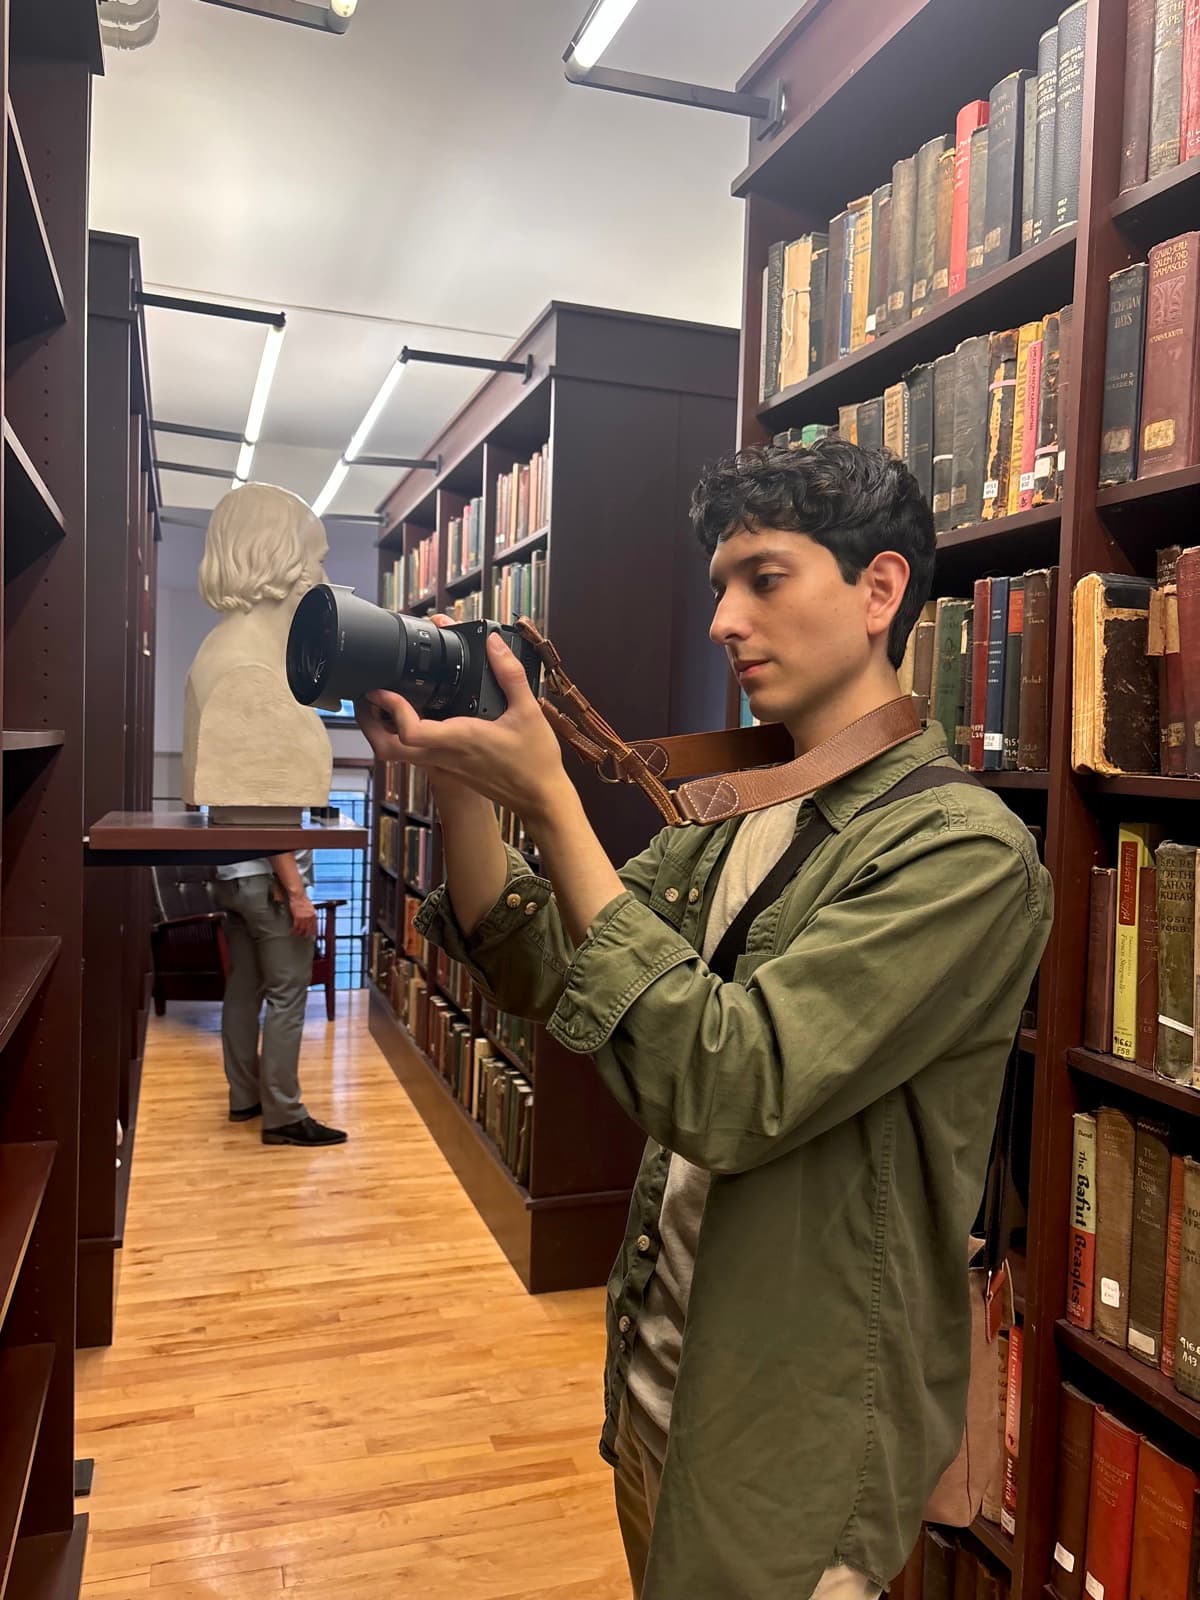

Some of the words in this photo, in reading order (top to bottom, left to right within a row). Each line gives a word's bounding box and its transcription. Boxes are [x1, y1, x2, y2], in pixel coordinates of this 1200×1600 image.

[1060, 45, 1081, 63] SIBERIA
[1071, 51, 1084, 62] THE
[1059, 68, 1081, 87] SYSTEM
[1061, 62, 1078, 77] EXILE
[1153, 261, 1188, 278] DAMASCUS
[1160, 880, 1193, 890] SAHAR
[1160, 891, 1193, 902] KUFAR
[1079, 1151, 1087, 1170] The
[1075, 1174, 1091, 1227] Bafut
[1069, 1233, 1087, 1303] Beagles
